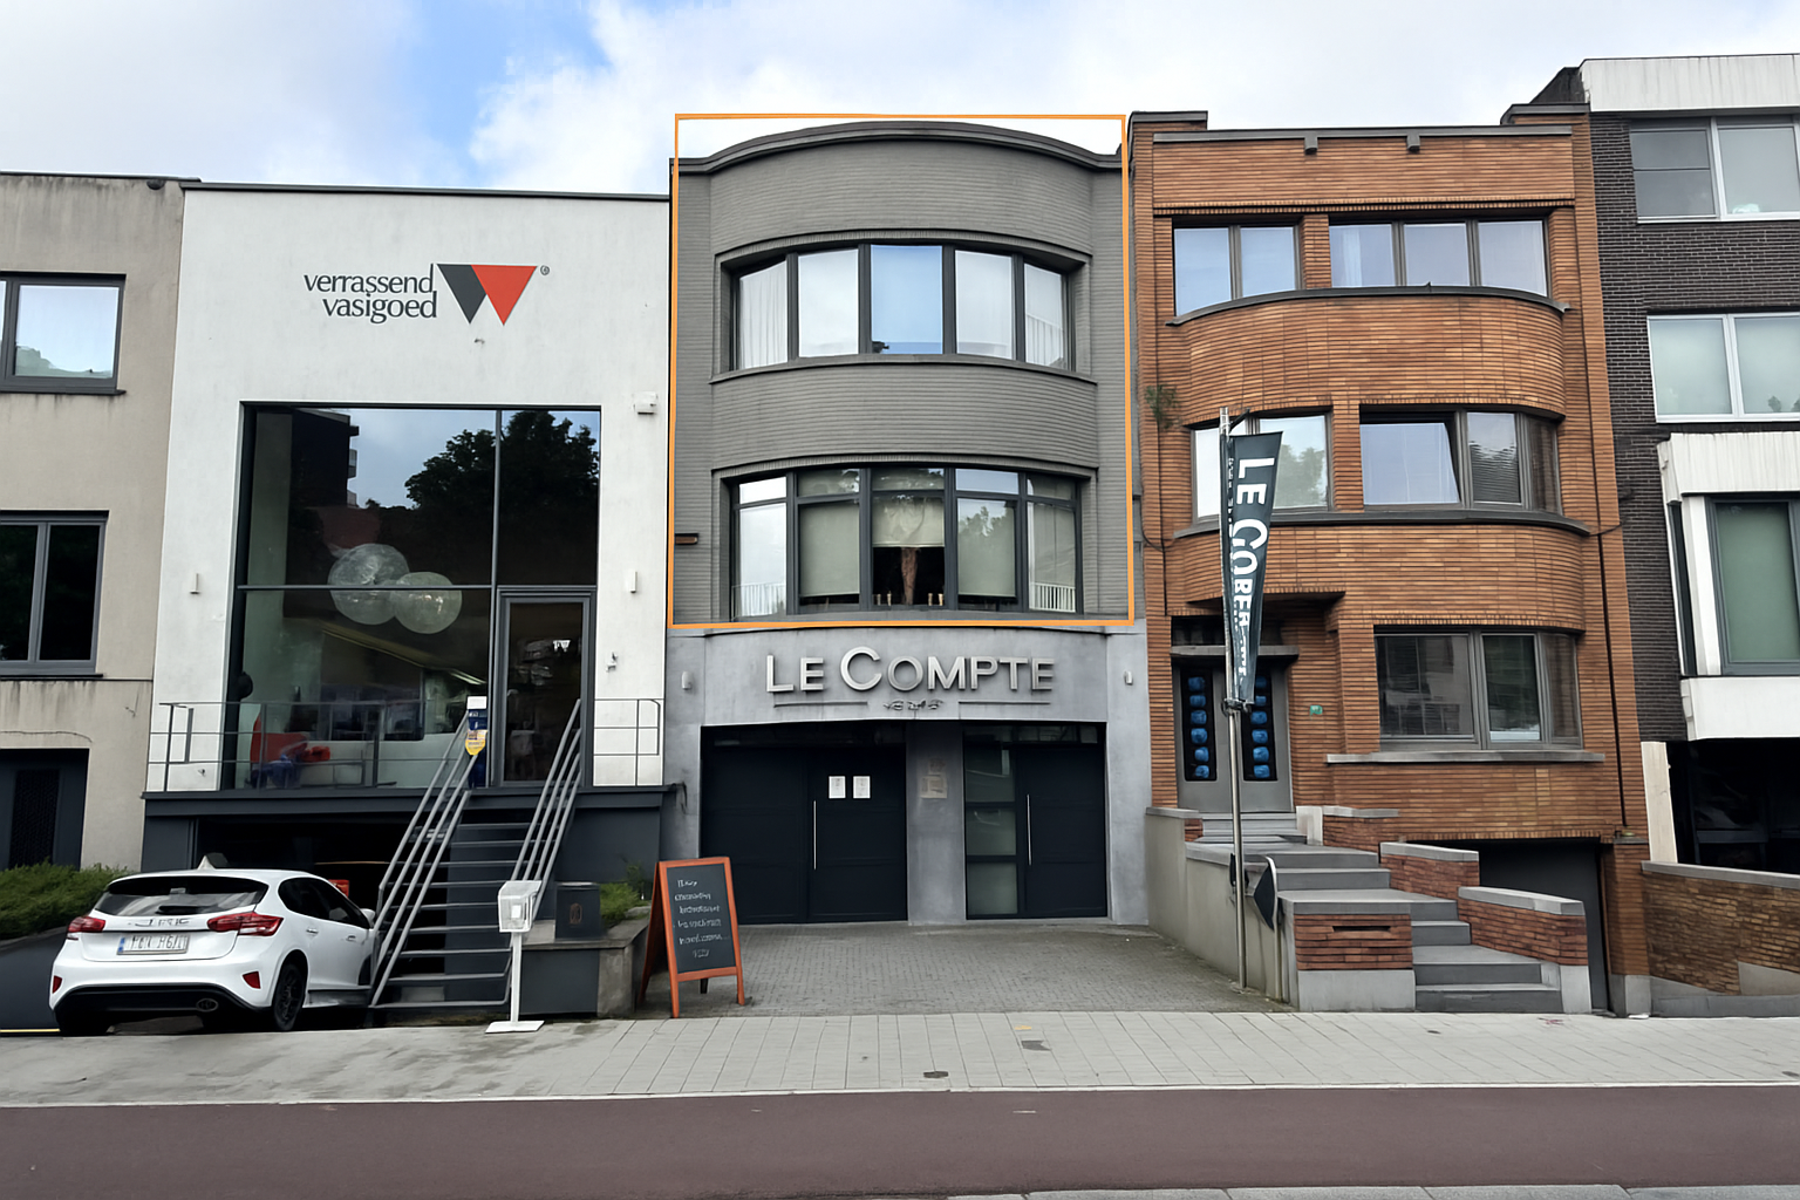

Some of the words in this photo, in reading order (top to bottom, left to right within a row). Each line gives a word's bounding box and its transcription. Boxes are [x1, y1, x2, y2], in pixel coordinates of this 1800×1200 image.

[303, 263, 434, 293] verrassend
[321, 291, 437, 324] vasigoed
[1235, 457, 1276, 506] LE
[766, 655, 825, 693] LE
[840, 646, 1056, 692] COMPTE
